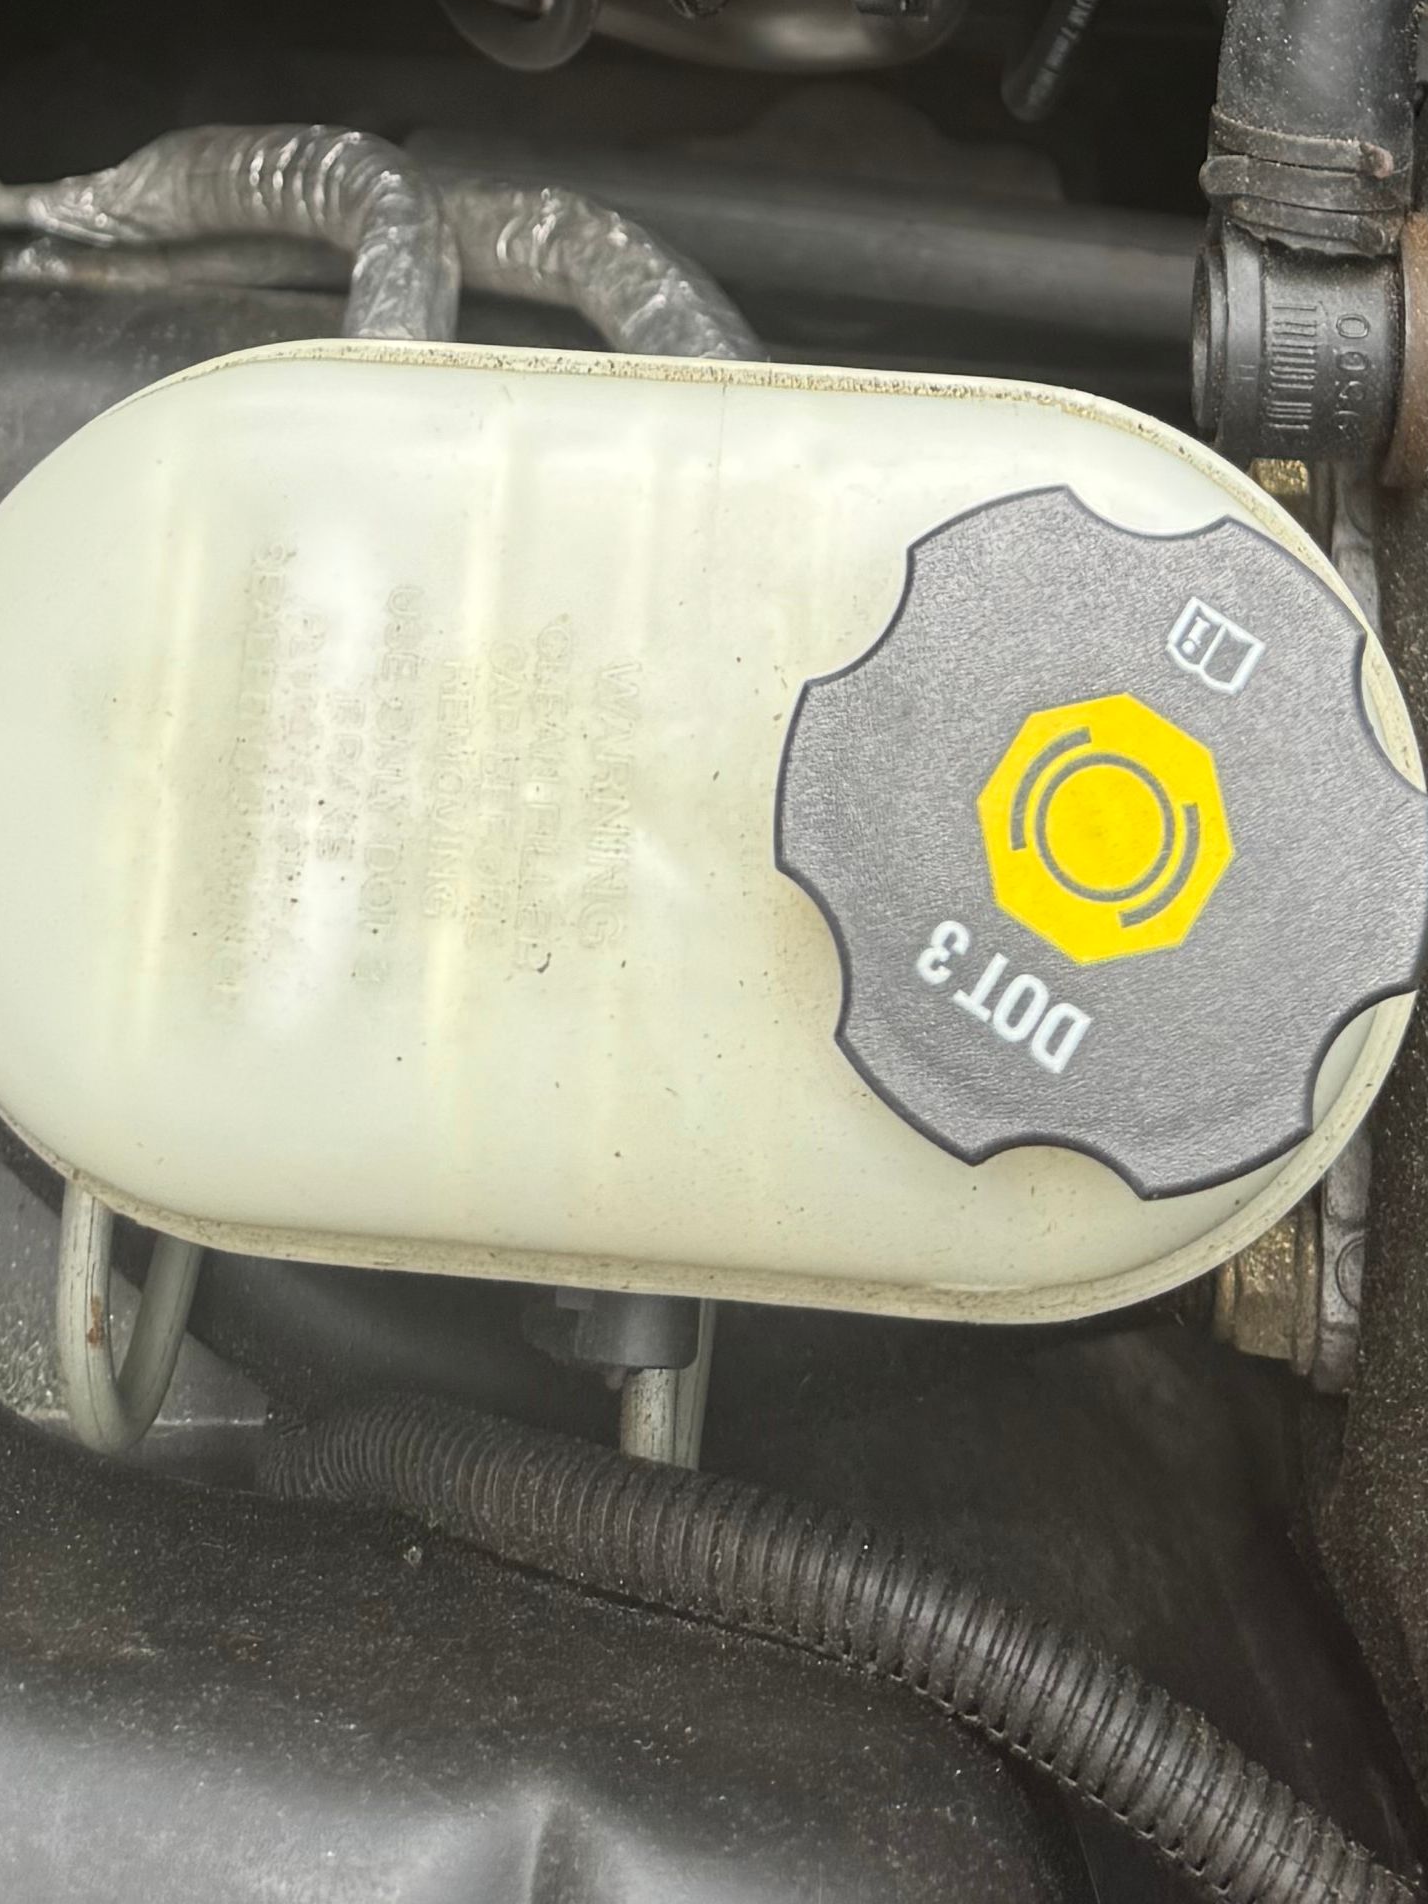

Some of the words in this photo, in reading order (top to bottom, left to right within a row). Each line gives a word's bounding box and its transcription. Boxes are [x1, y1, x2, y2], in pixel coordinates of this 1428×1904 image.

[423, 660, 473, 920] REMOVING
[577, 661, 644, 951] WARNING
[917, 920, 970, 985] 3
[953, 952, 1093, 1074] DOT
